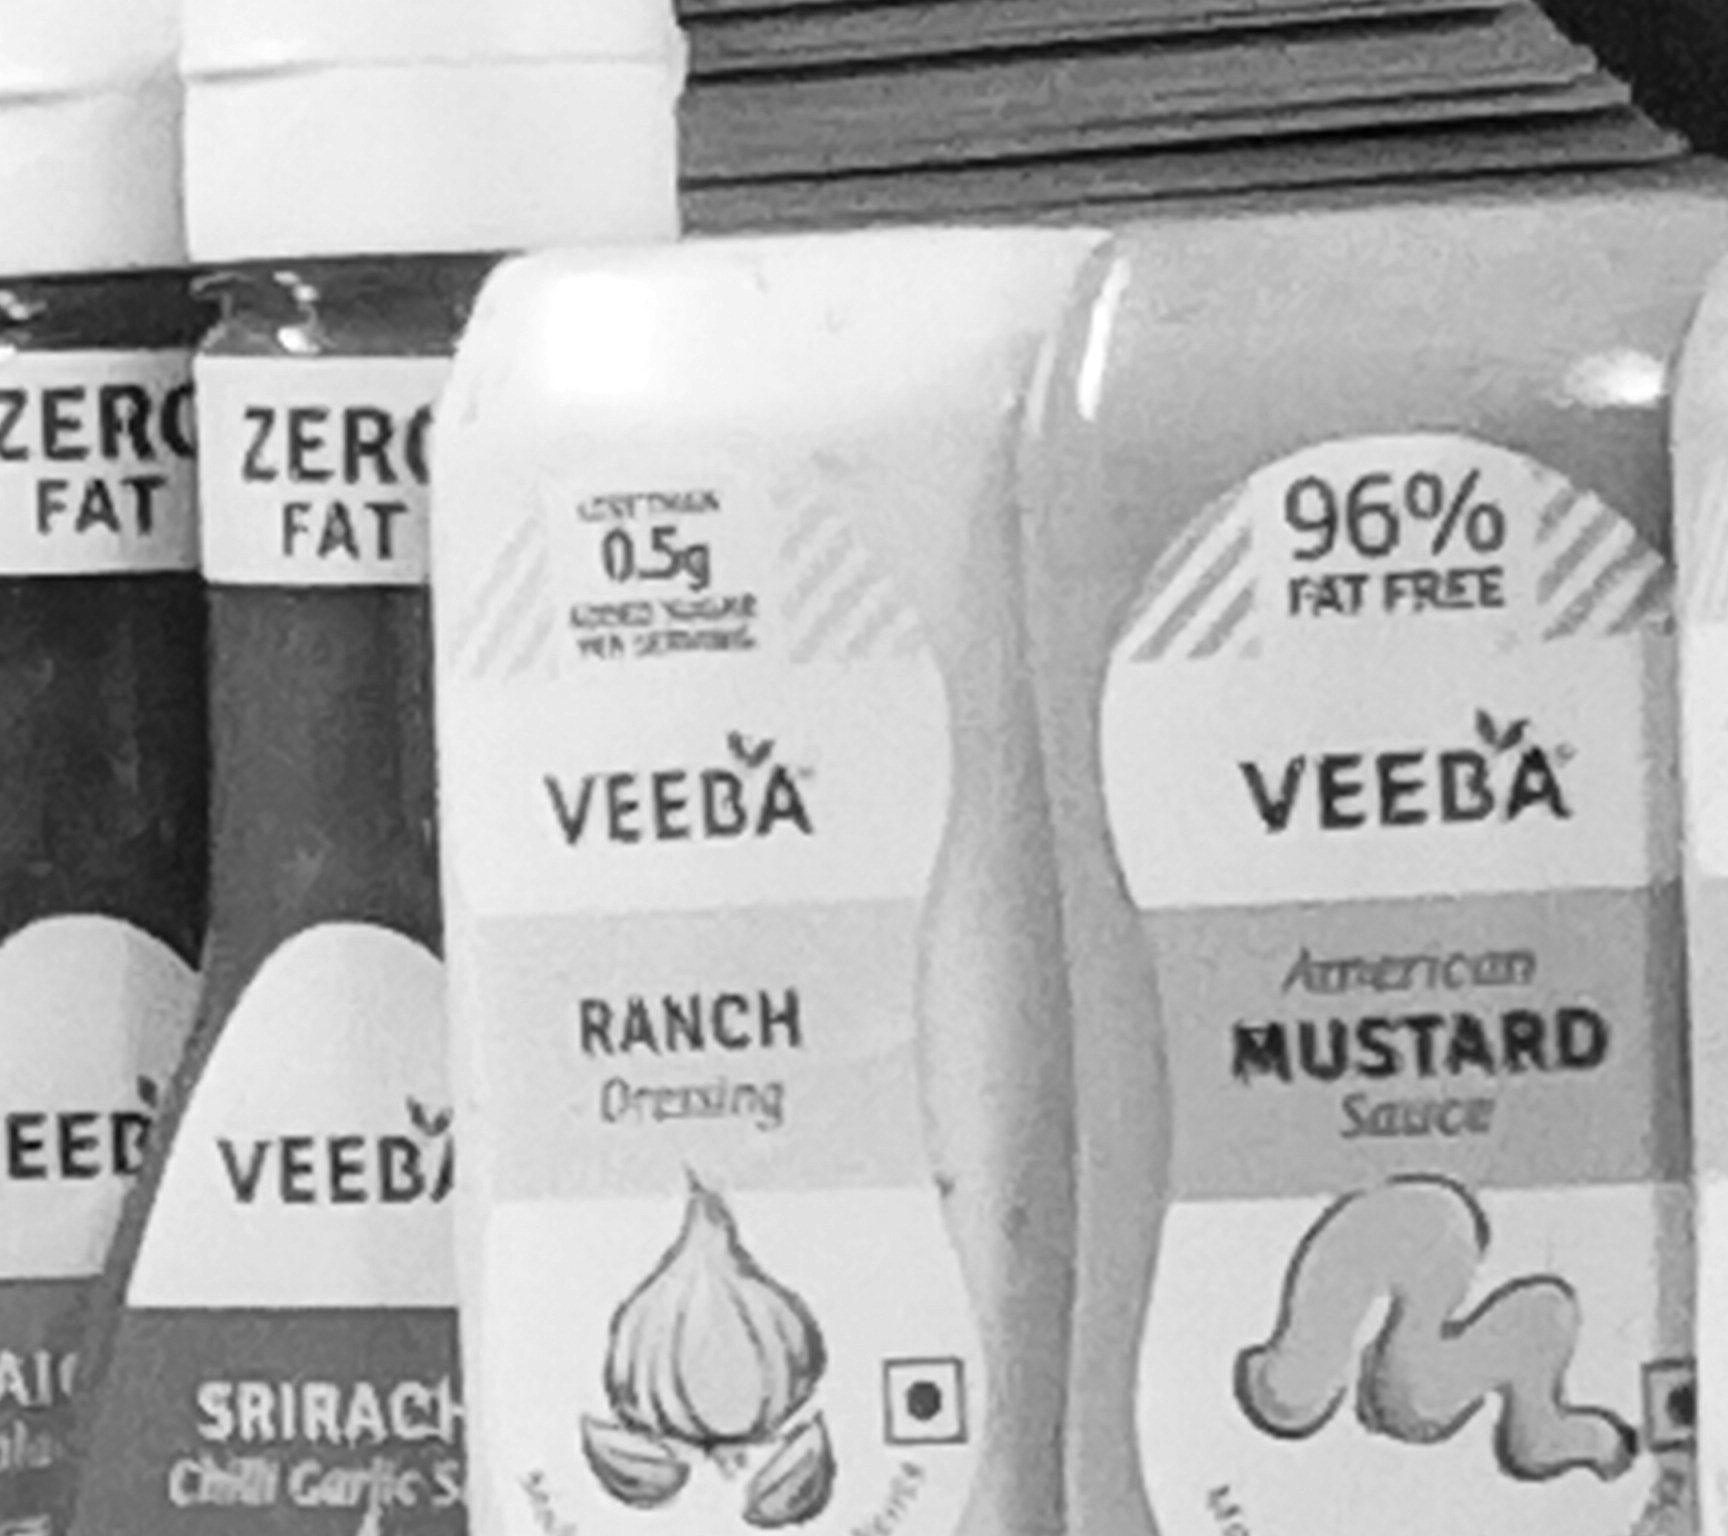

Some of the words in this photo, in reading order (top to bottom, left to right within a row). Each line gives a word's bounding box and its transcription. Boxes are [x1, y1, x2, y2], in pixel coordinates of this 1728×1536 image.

[36, 475, 168, 536] FAT
[281, 500, 408, 560] FAT
[1283, 468, 1506, 561] 96%
[601, 525, 712, 593] 0.5g
[1287, 573, 1370, 617] FAT
[1382, 566, 1506, 613] FREE
[543, 764, 813, 847] VEEBA
[1237, 746, 1575, 835] VEEBA
[1280, 946, 1537, 995] American
[578, 985, 803, 1056] RANCH
[1230, 1006, 1610, 1085] MUSTARD
[600, 1076, 786, 1132] Dressing
[1339, 1093, 1498, 1140] Sauce
